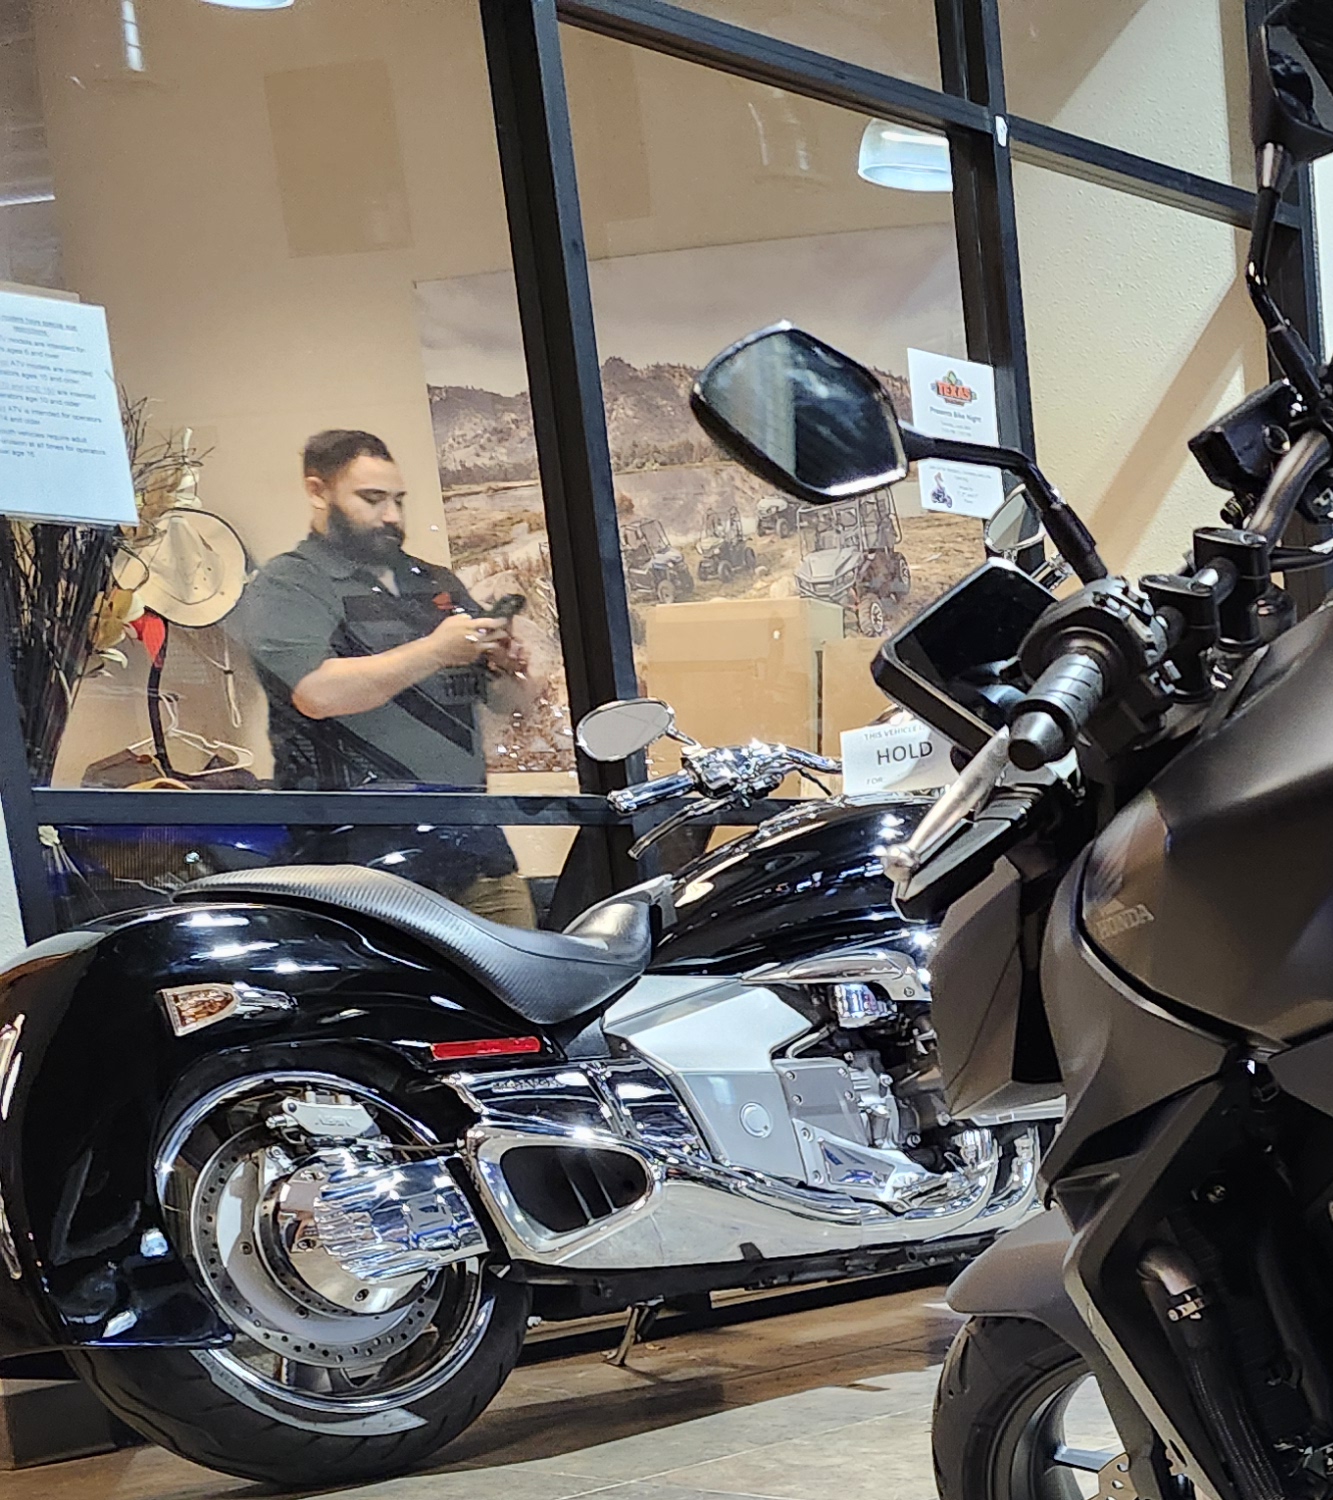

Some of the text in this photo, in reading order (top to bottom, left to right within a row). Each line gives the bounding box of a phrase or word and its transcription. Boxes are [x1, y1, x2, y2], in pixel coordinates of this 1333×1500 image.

[936, 380, 972, 402] TEXAS
[864, 730, 883, 741] THIS
[884, 724, 918, 738] VEHICLE
[876, 741, 934, 766] HOLD
[866, 776, 884, 786] FOR
[1095, 903, 1156, 941] HONDA
